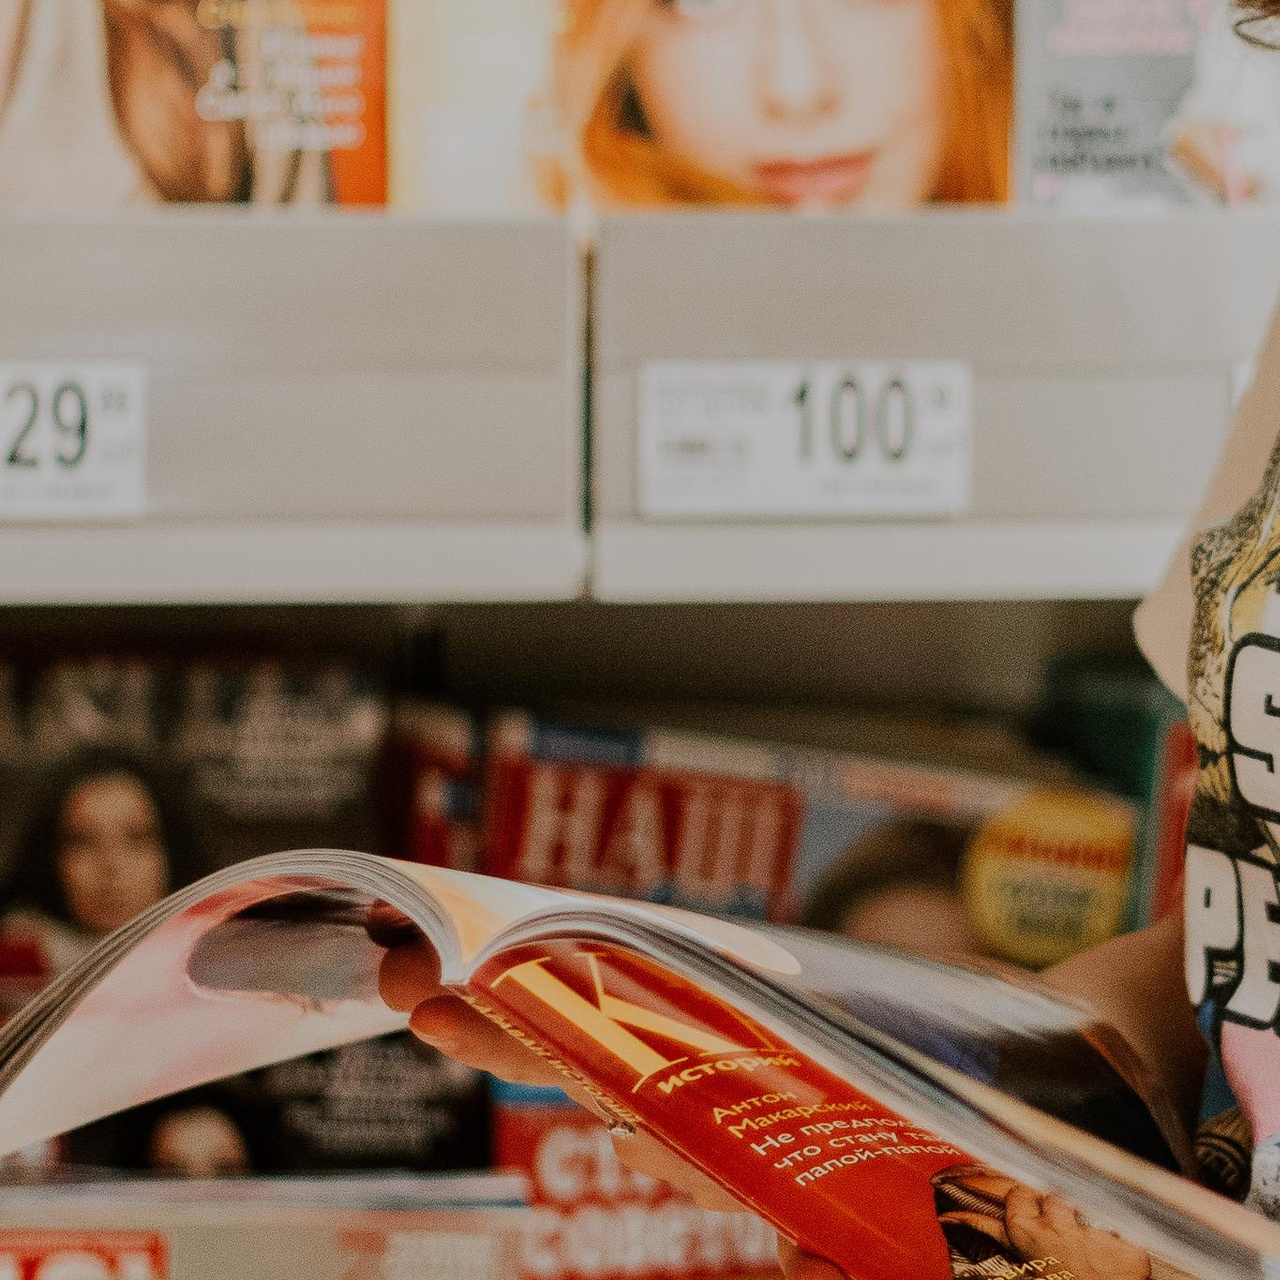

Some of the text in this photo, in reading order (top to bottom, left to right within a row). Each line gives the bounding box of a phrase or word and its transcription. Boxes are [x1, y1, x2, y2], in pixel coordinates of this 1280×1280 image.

[793, 375, 914, 466] 100
[656, 1050, 802, 1094] историй
[711, 1090, 796, 1124] Антон
[726, 1101, 876, 1140] Макарский
[750, 1129, 796, 1157] Не
[773, 1144, 822, 1170] что
[828, 1128, 899, 1148] стану
[794, 1144, 961, 1187] папой-папой
